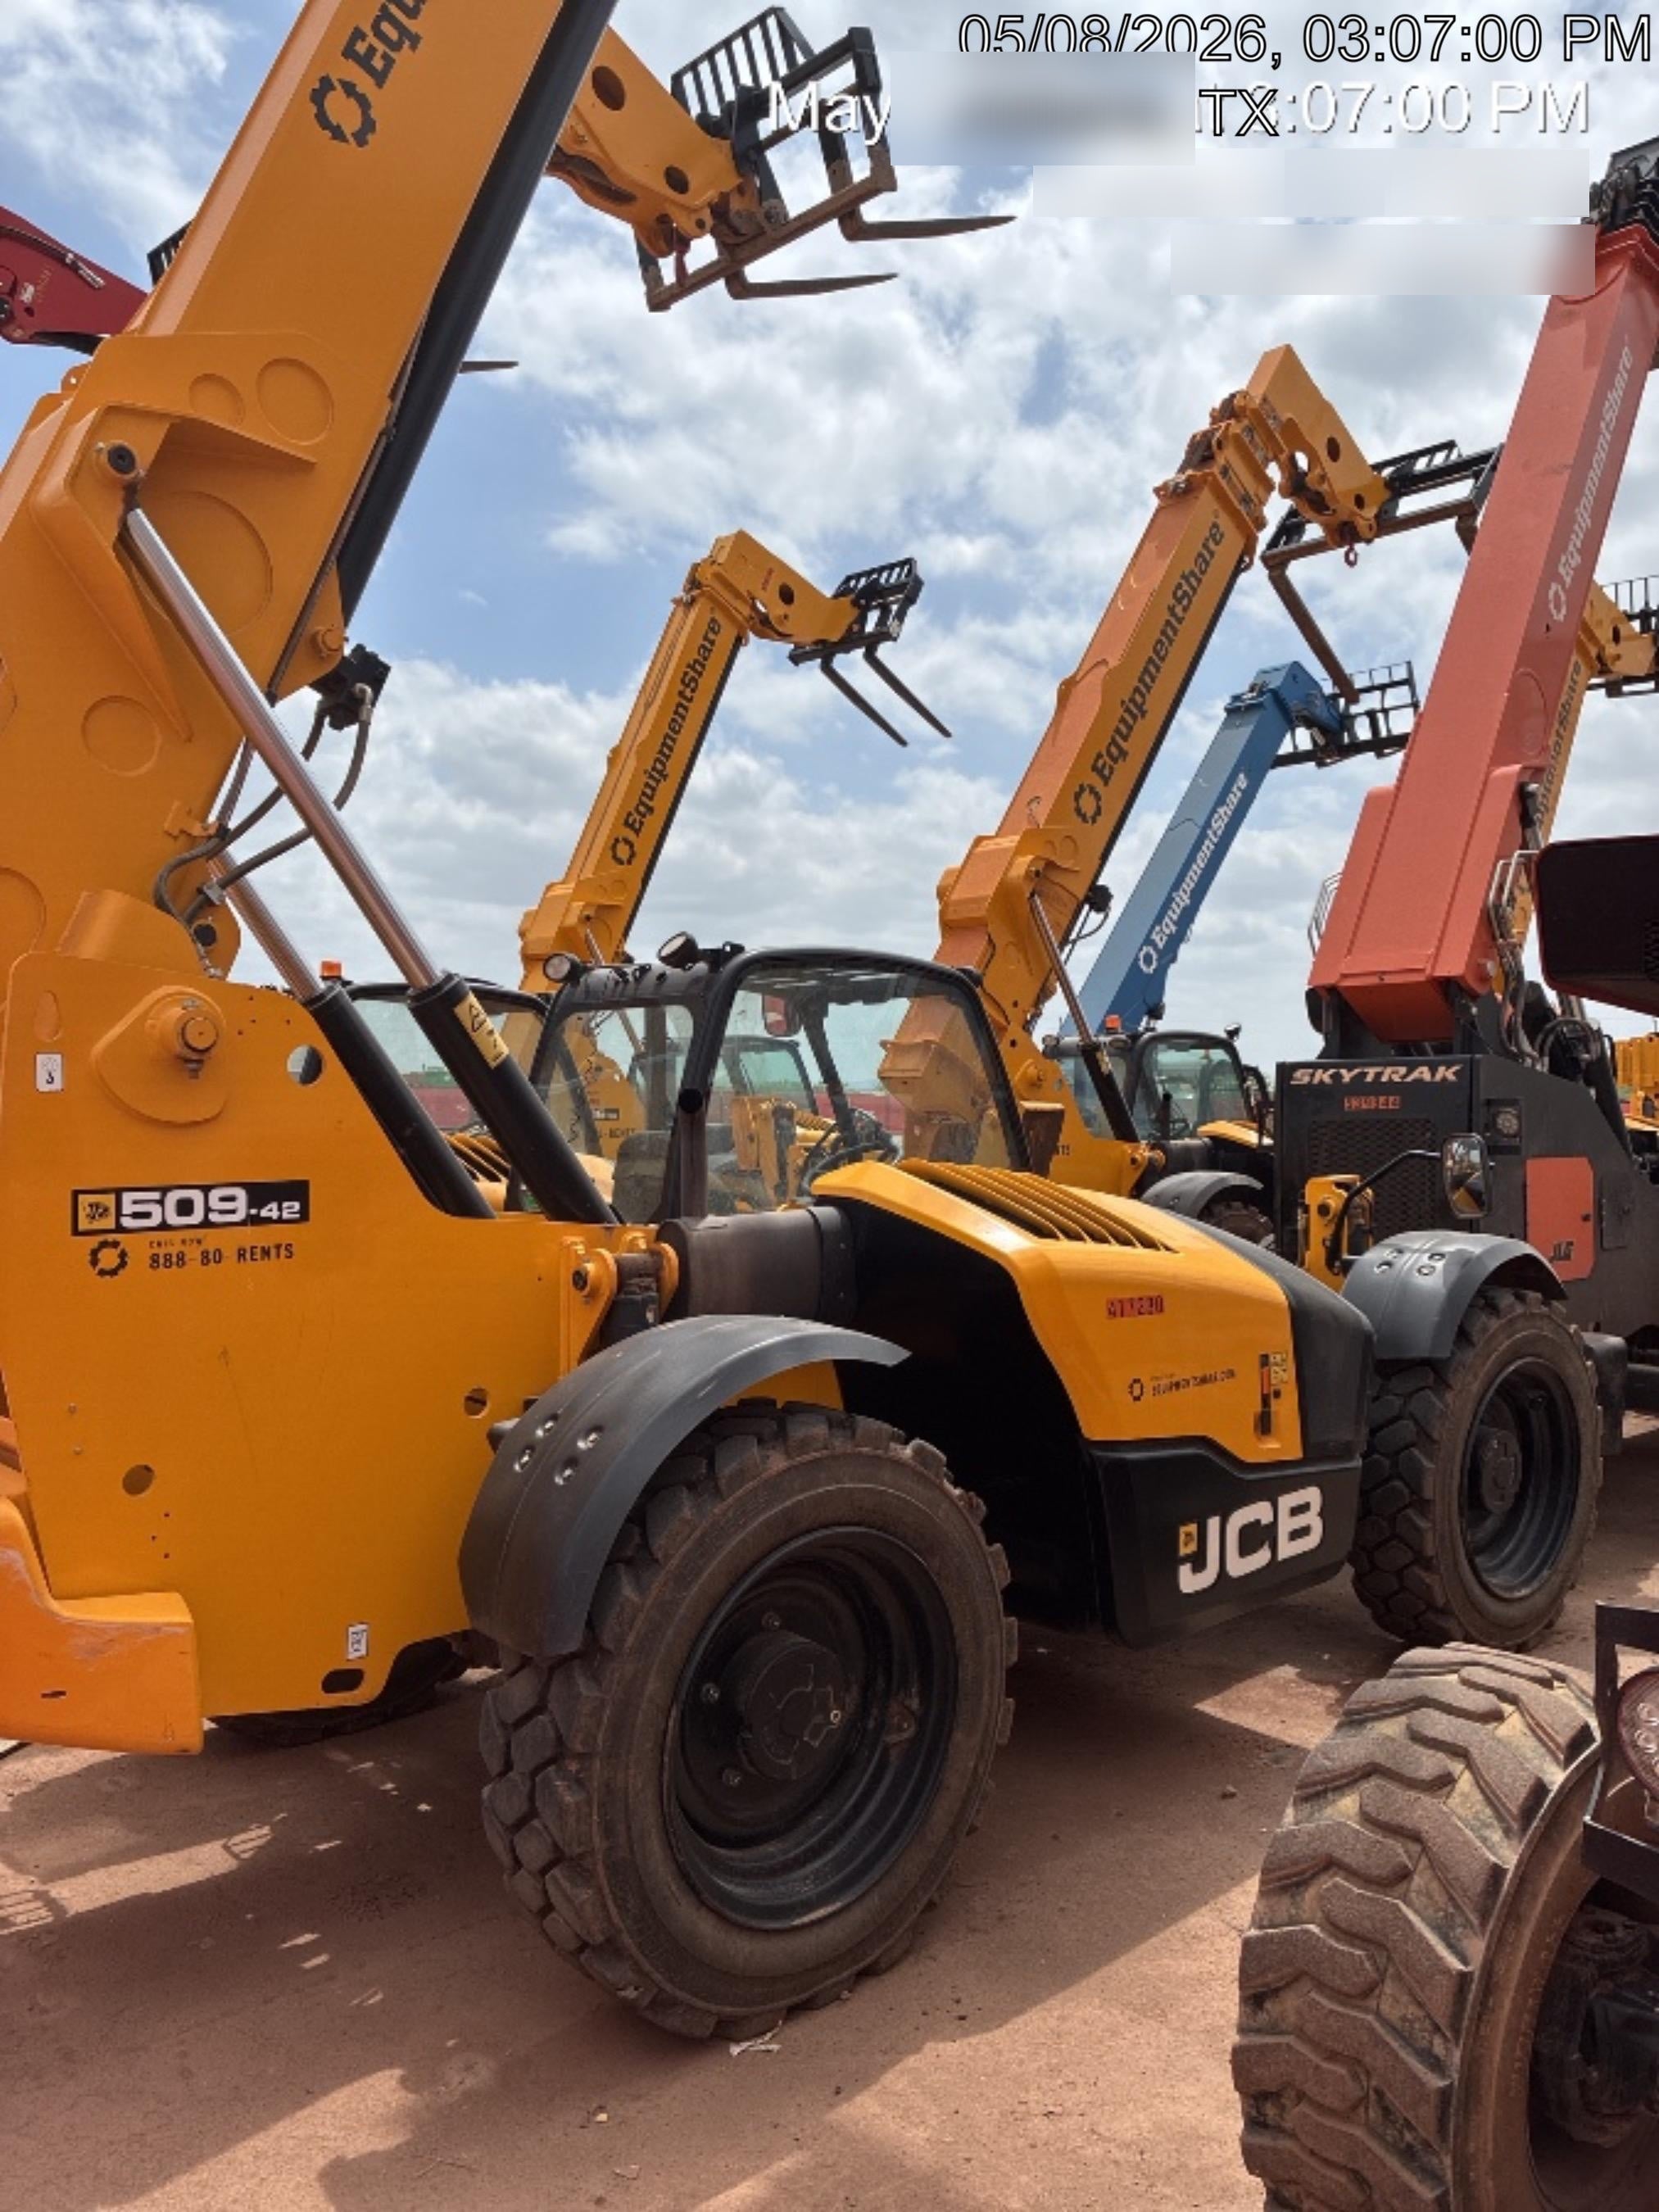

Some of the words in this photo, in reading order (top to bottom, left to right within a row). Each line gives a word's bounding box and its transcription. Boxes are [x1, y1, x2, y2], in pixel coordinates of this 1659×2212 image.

[1558, 346, 1633, 588] EquipmentShare
[623, 615, 721, 837] EquipmentShare
[1090, 518, 1225, 786] EquipmentShare
[1150, 773, 1248, 949] EquipmentShare
[1290, 1064, 1464, 1085] SKYTRAK
[120, 1186, 301, 1228] 509-42
[1179, 1486, 1323, 1593] JCB
